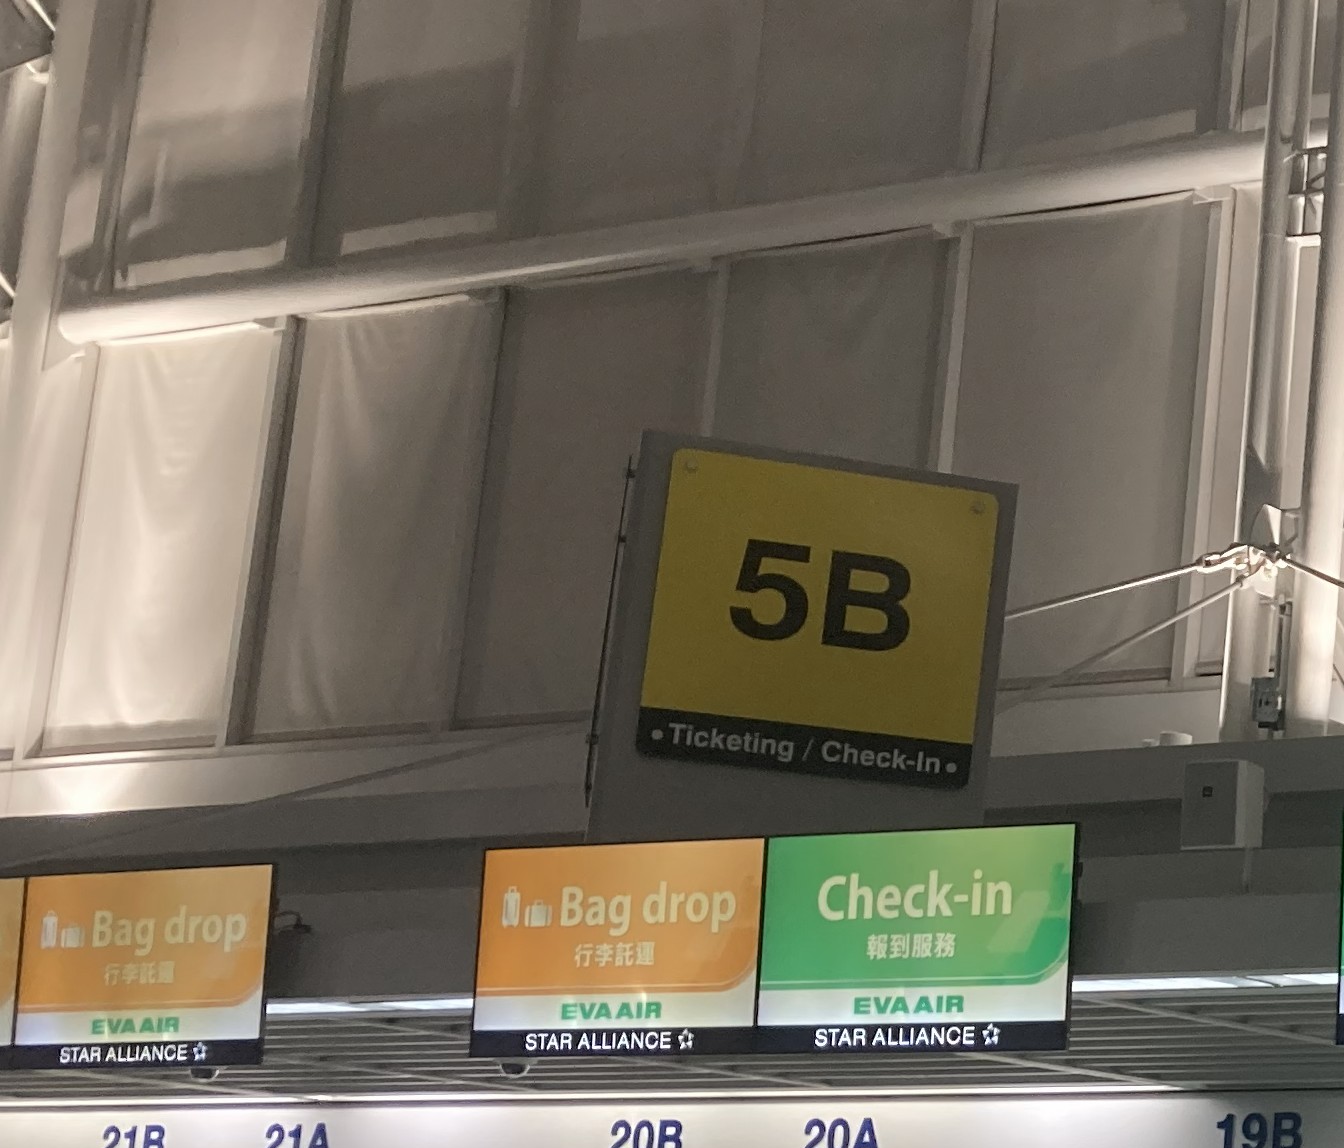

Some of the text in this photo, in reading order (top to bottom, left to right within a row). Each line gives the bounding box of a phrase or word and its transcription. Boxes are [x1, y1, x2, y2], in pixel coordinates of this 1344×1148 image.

[729, 538, 912, 652] 5B
[668, 722, 794, 761] Ticketing
[821, 739, 941, 774] Check-In
[560, 880, 737, 936] Bag drop
[817, 868, 1013, 921] Check-in
[91, 904, 247, 956] Bag drop
[867, 932, 956, 960] 報到服務
[574, 941, 656, 968] 行李託運
[59, 1044, 188, 1064] STAR ALLIANCE
[525, 1031, 672, 1050] STAR ALLIANCE
[814, 1026, 976, 1047] STAR ALLIANCE
